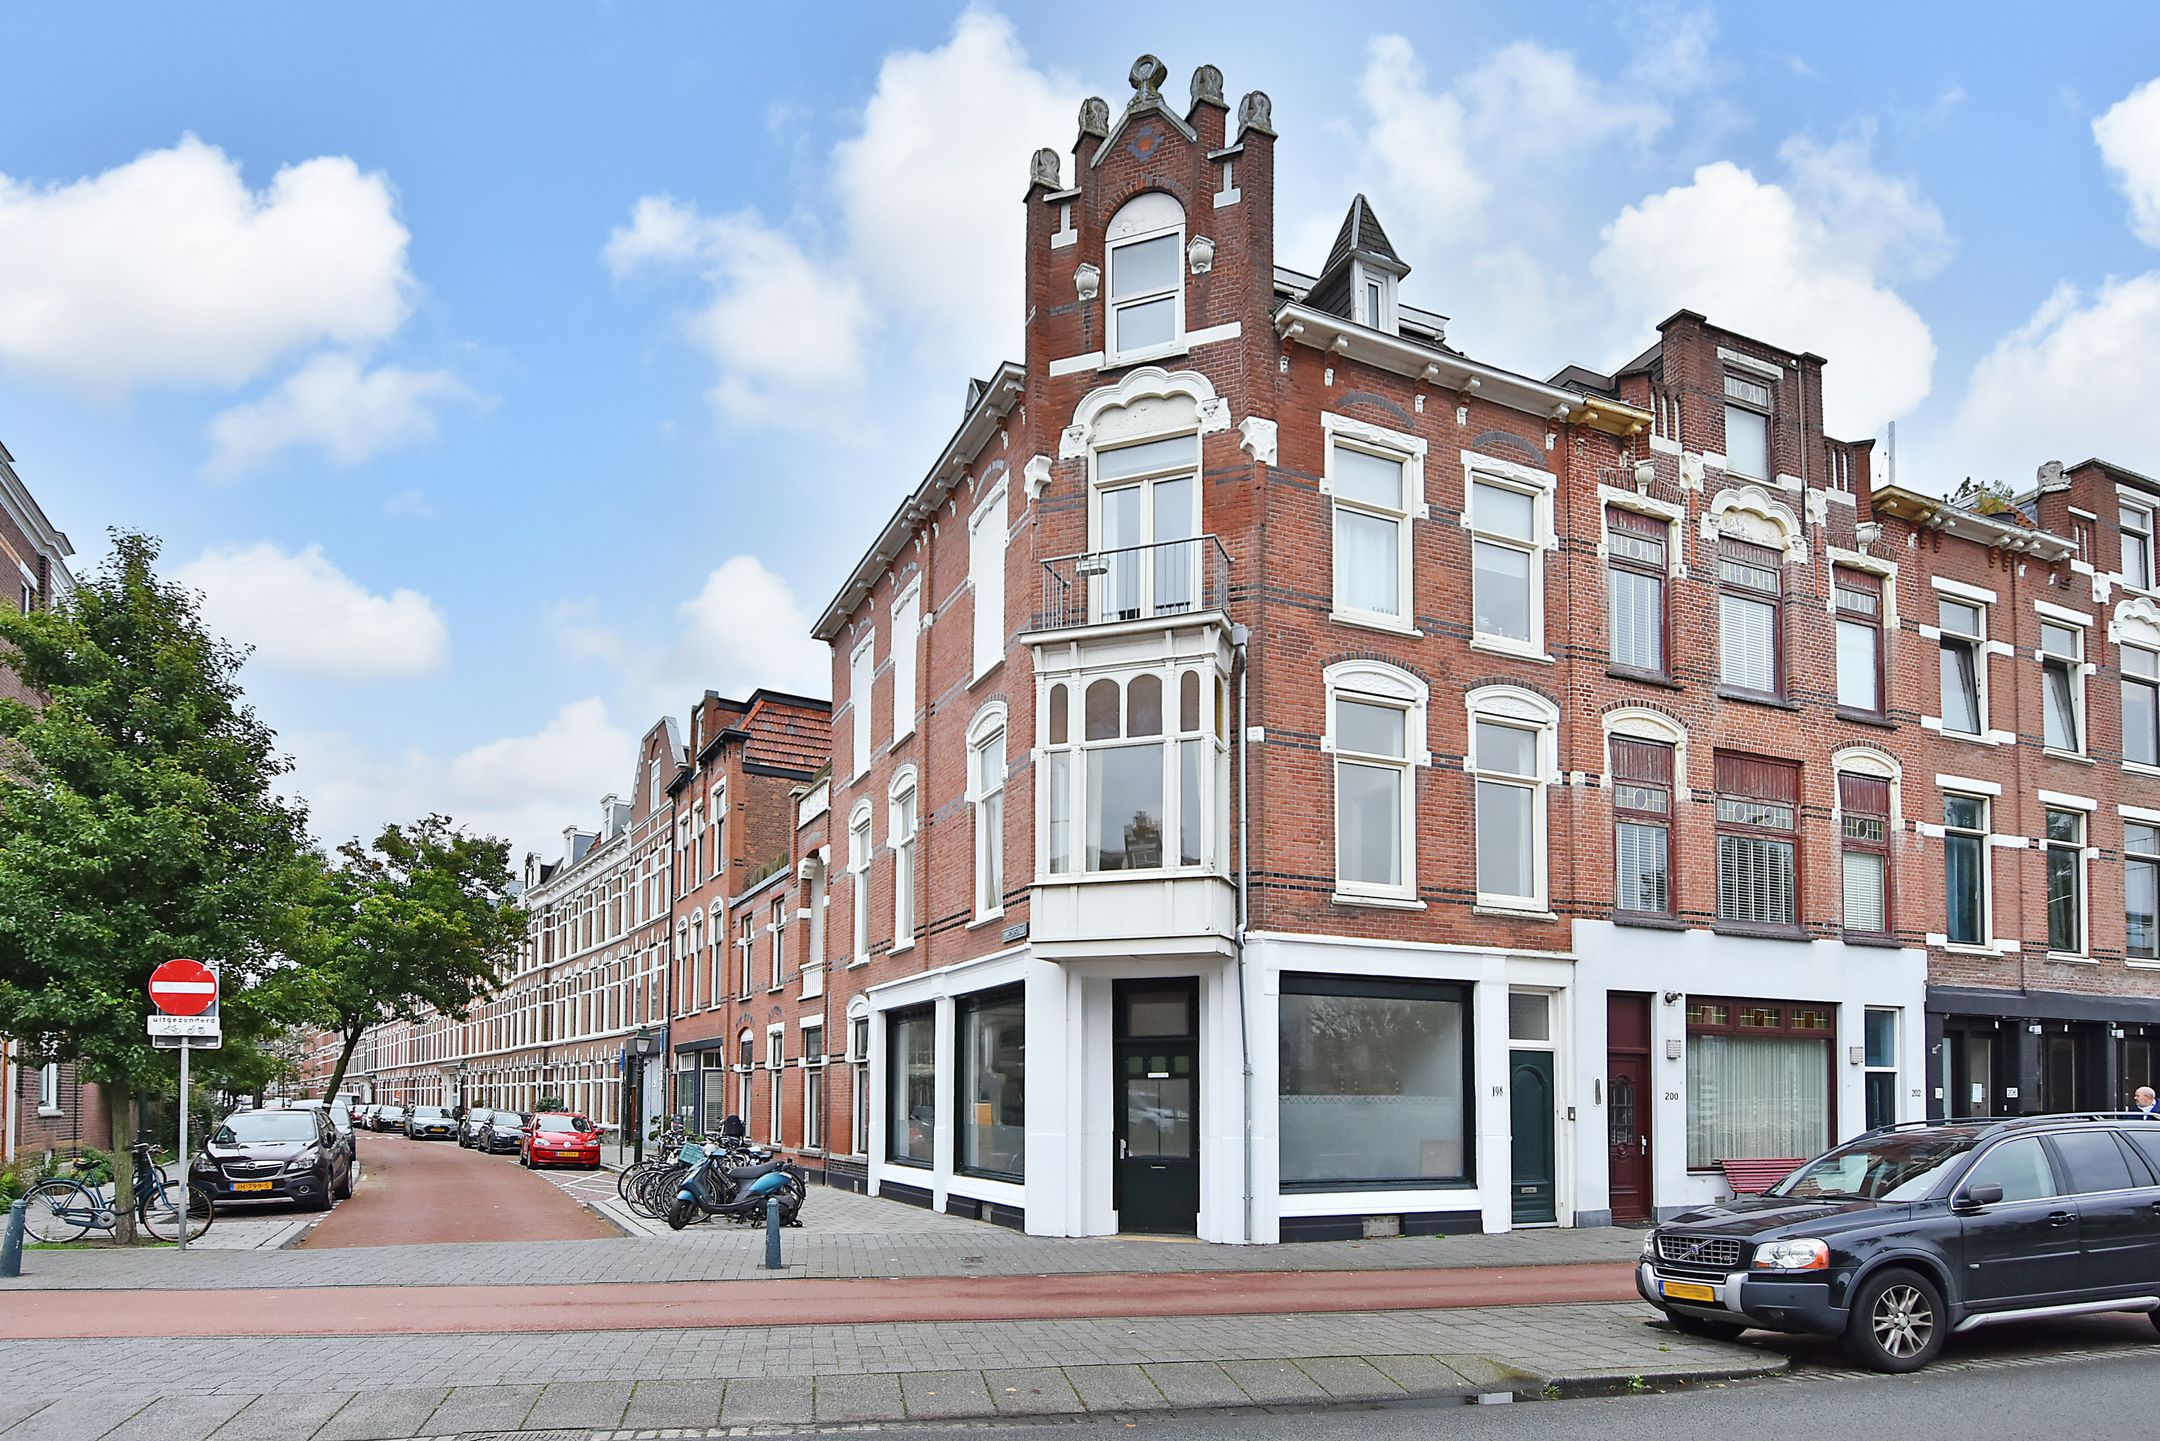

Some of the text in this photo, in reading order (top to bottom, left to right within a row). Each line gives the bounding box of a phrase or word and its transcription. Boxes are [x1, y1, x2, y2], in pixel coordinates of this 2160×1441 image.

[1492, 1085, 1504, 1097] 198
[1911, 1089, 1921, 1098] 202
[1664, 1092, 1679, 1101] 200
